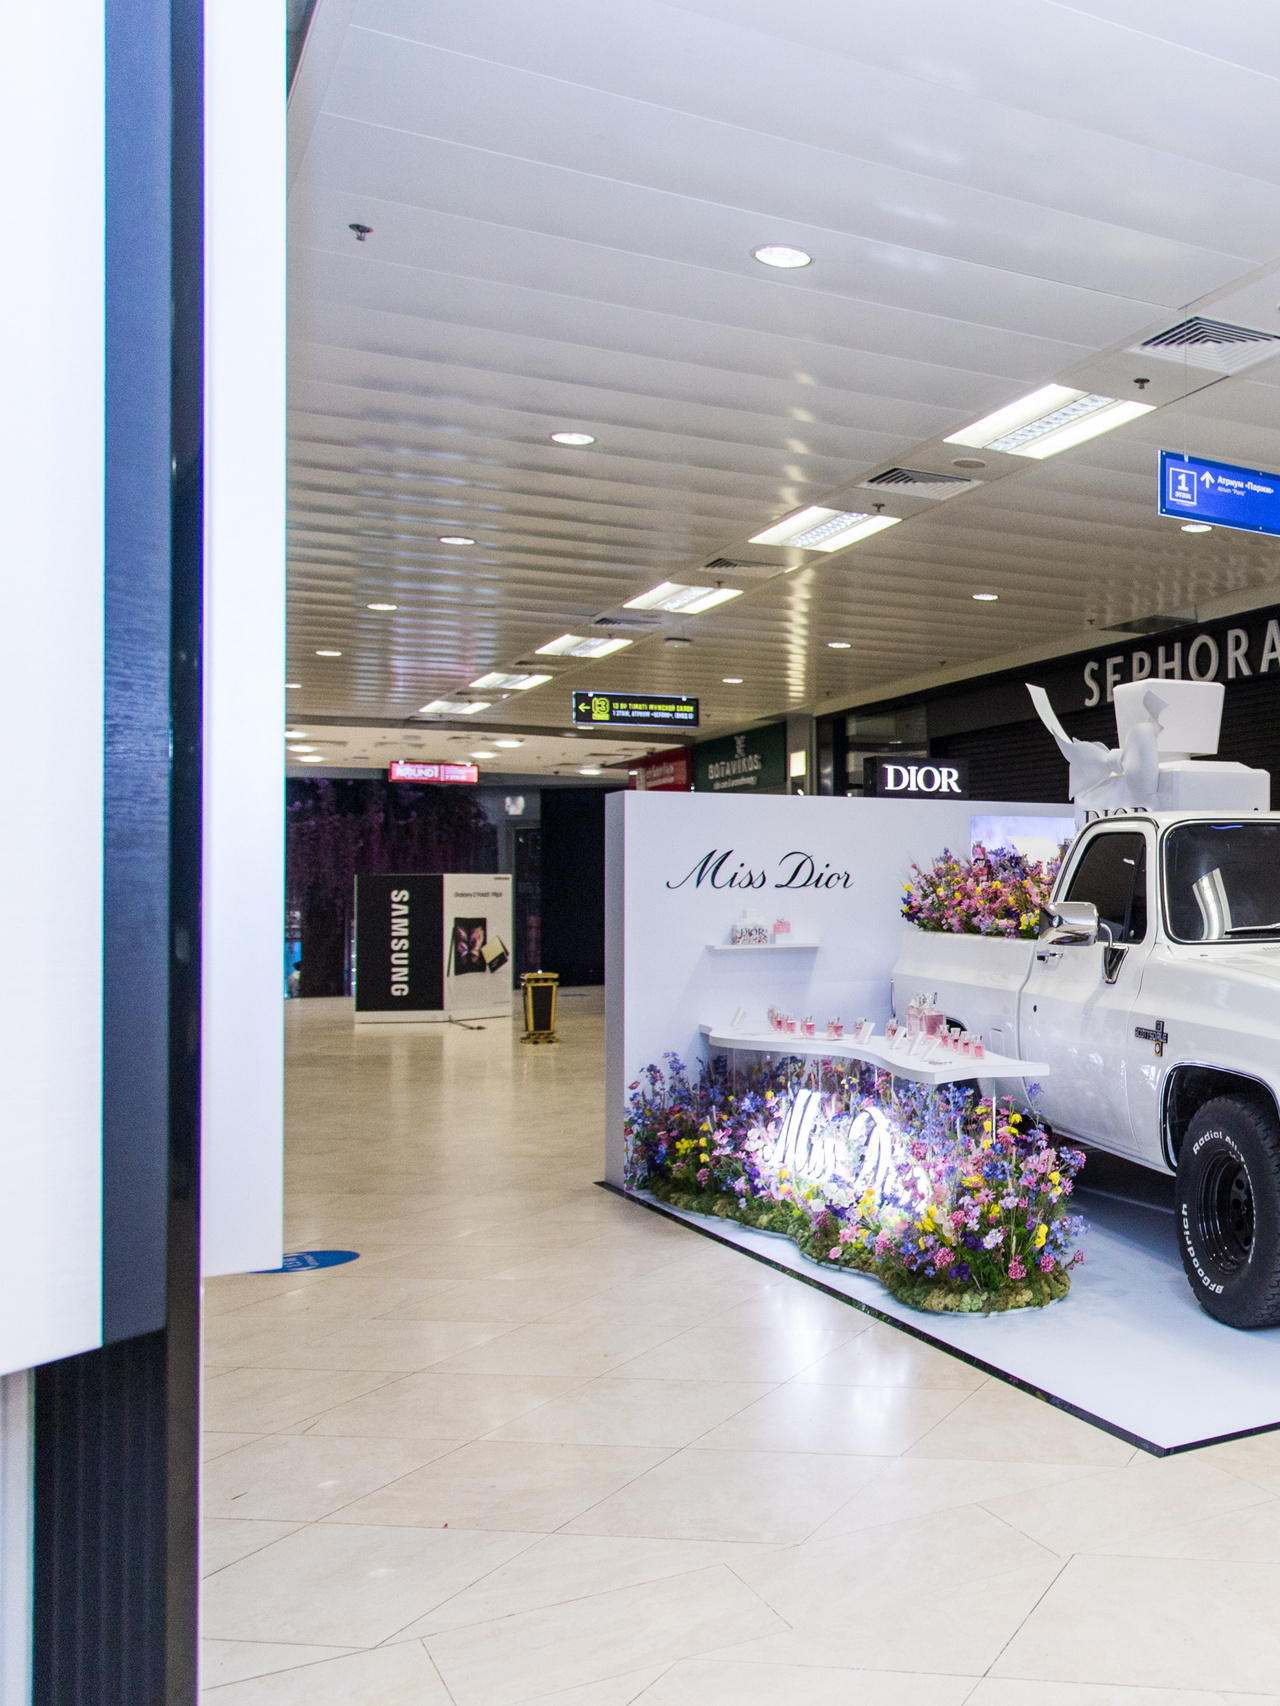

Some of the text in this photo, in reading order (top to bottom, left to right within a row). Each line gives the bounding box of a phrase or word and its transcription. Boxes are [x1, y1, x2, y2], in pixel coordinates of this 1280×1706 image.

[1177, 473, 1189, 491] 1
[1217, 475, 1244, 489] Атриум
[883, 764, 962, 793] DIOR
[666, 849, 854, 889] Miss Dior
[390, 889, 410, 996] SAMSUNG
[1192, 1130, 1223, 1156] Radial
[1181, 1203, 1225, 1294] BFGoodrich
